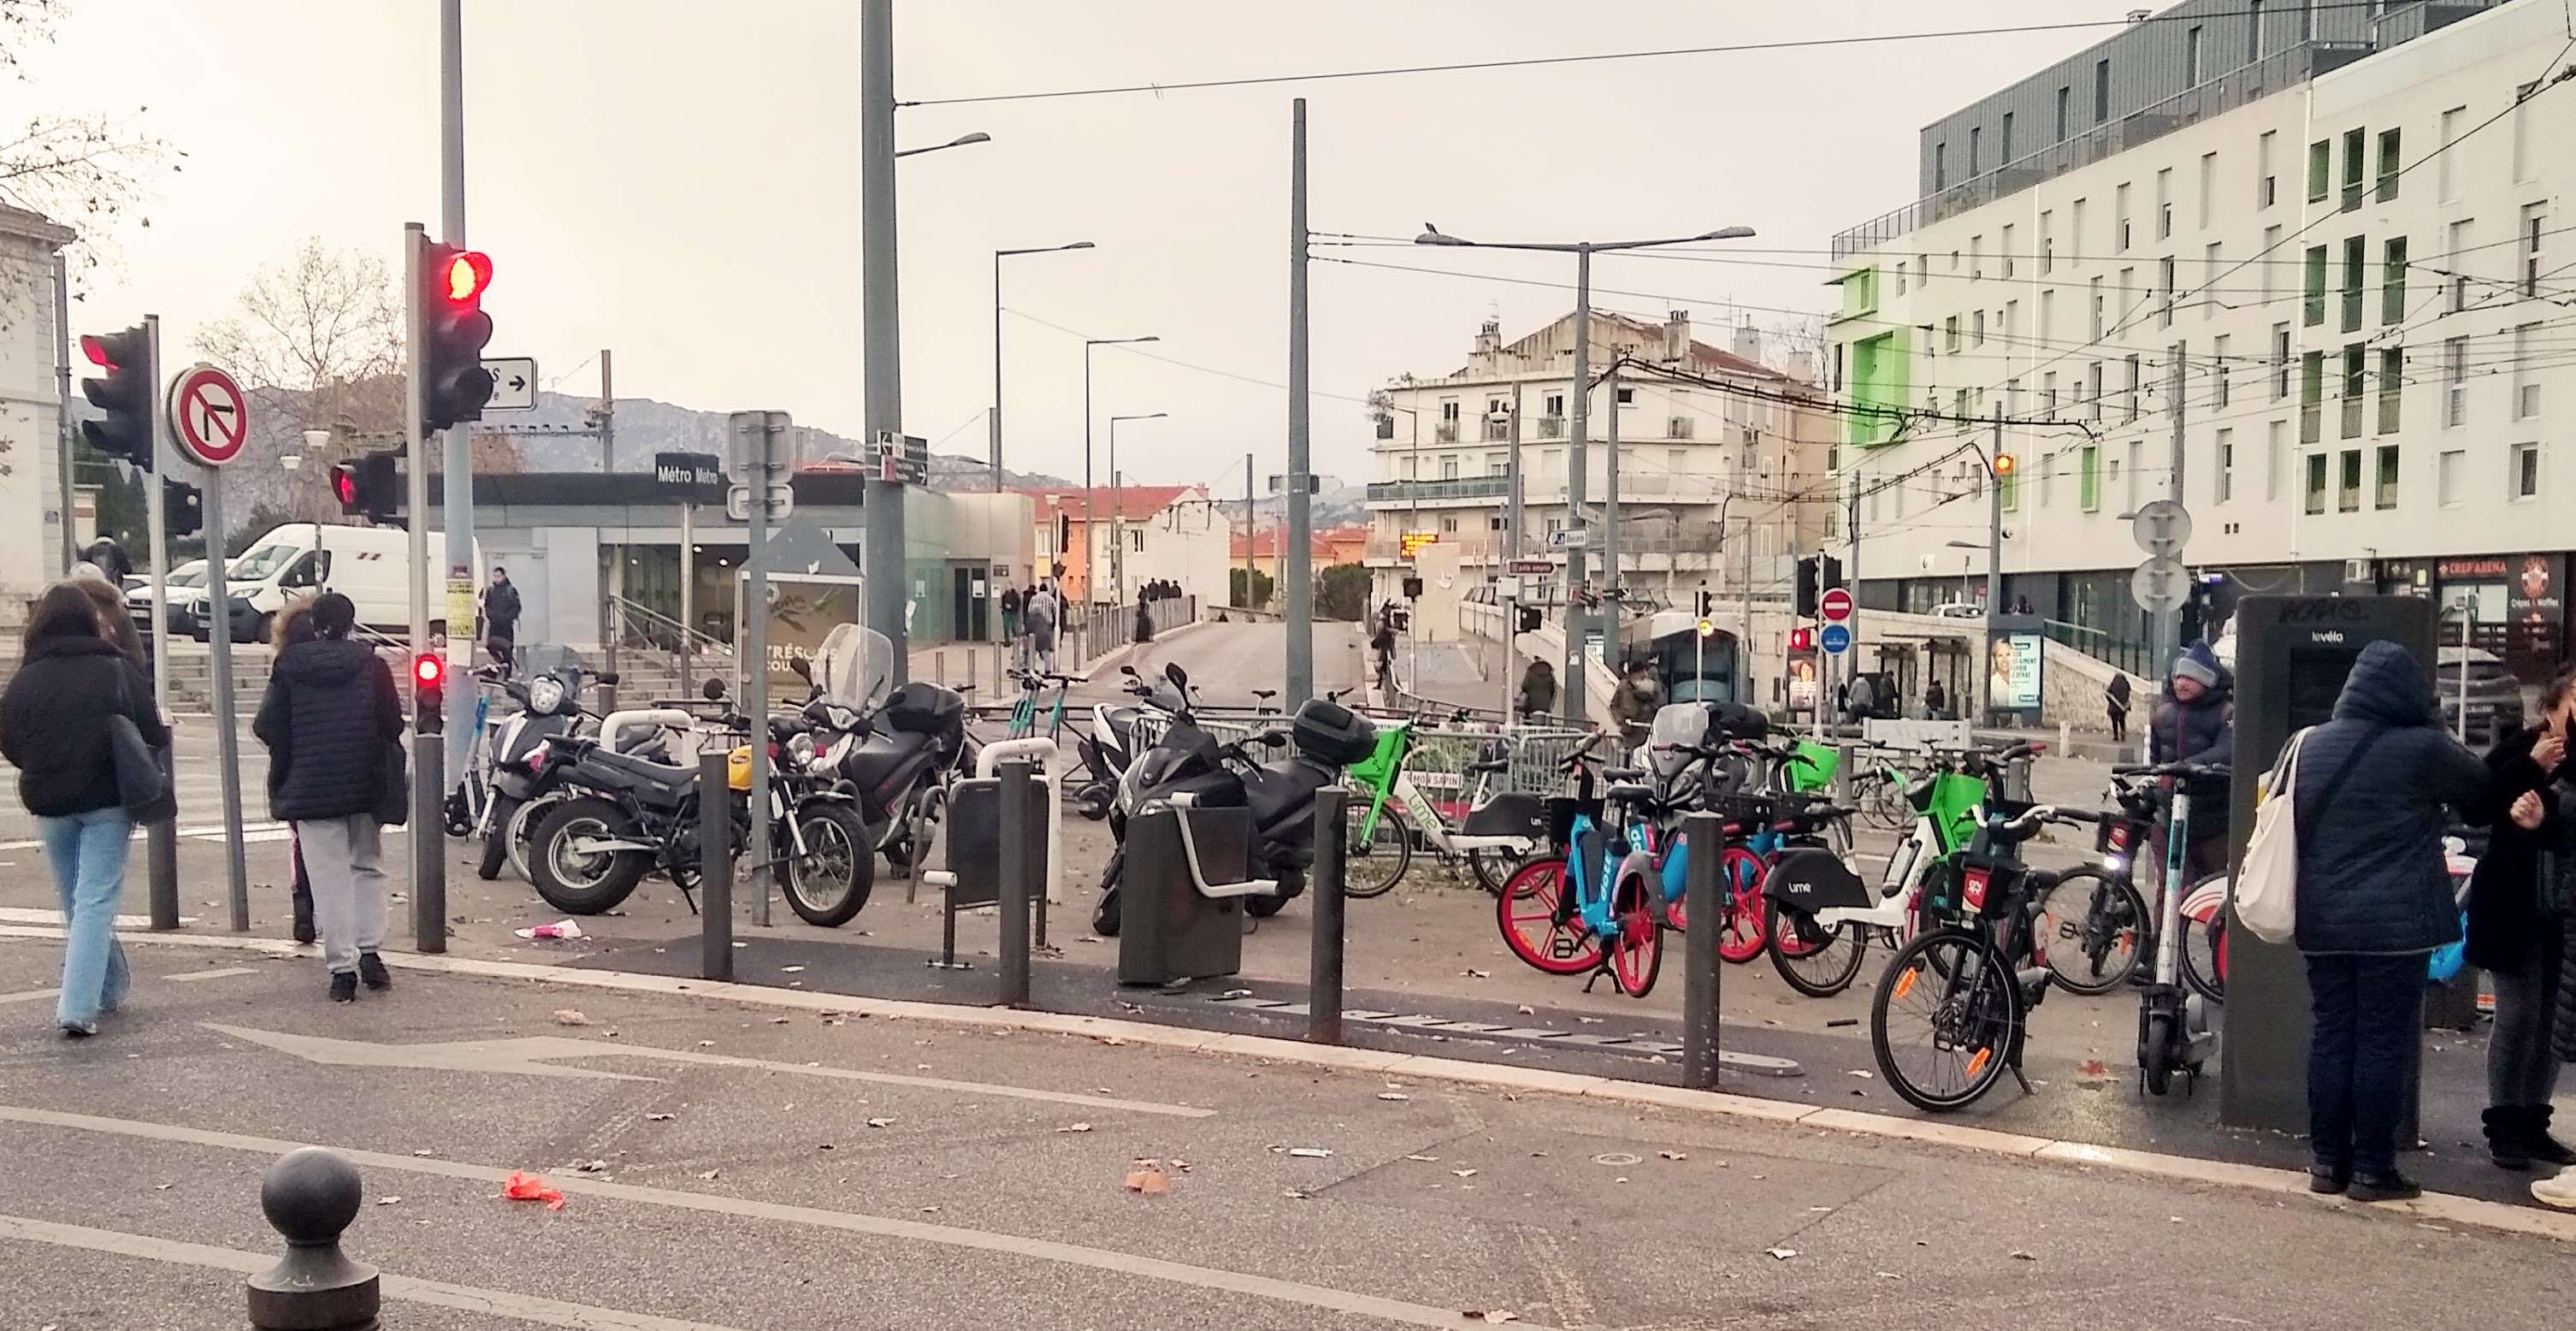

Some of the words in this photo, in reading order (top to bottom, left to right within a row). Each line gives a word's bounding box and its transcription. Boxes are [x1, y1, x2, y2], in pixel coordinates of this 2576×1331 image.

[658, 465, 692, 483] Métro
[2312, 630, 2343, 643] levélo
[1600, 855, 1612, 902] dott
